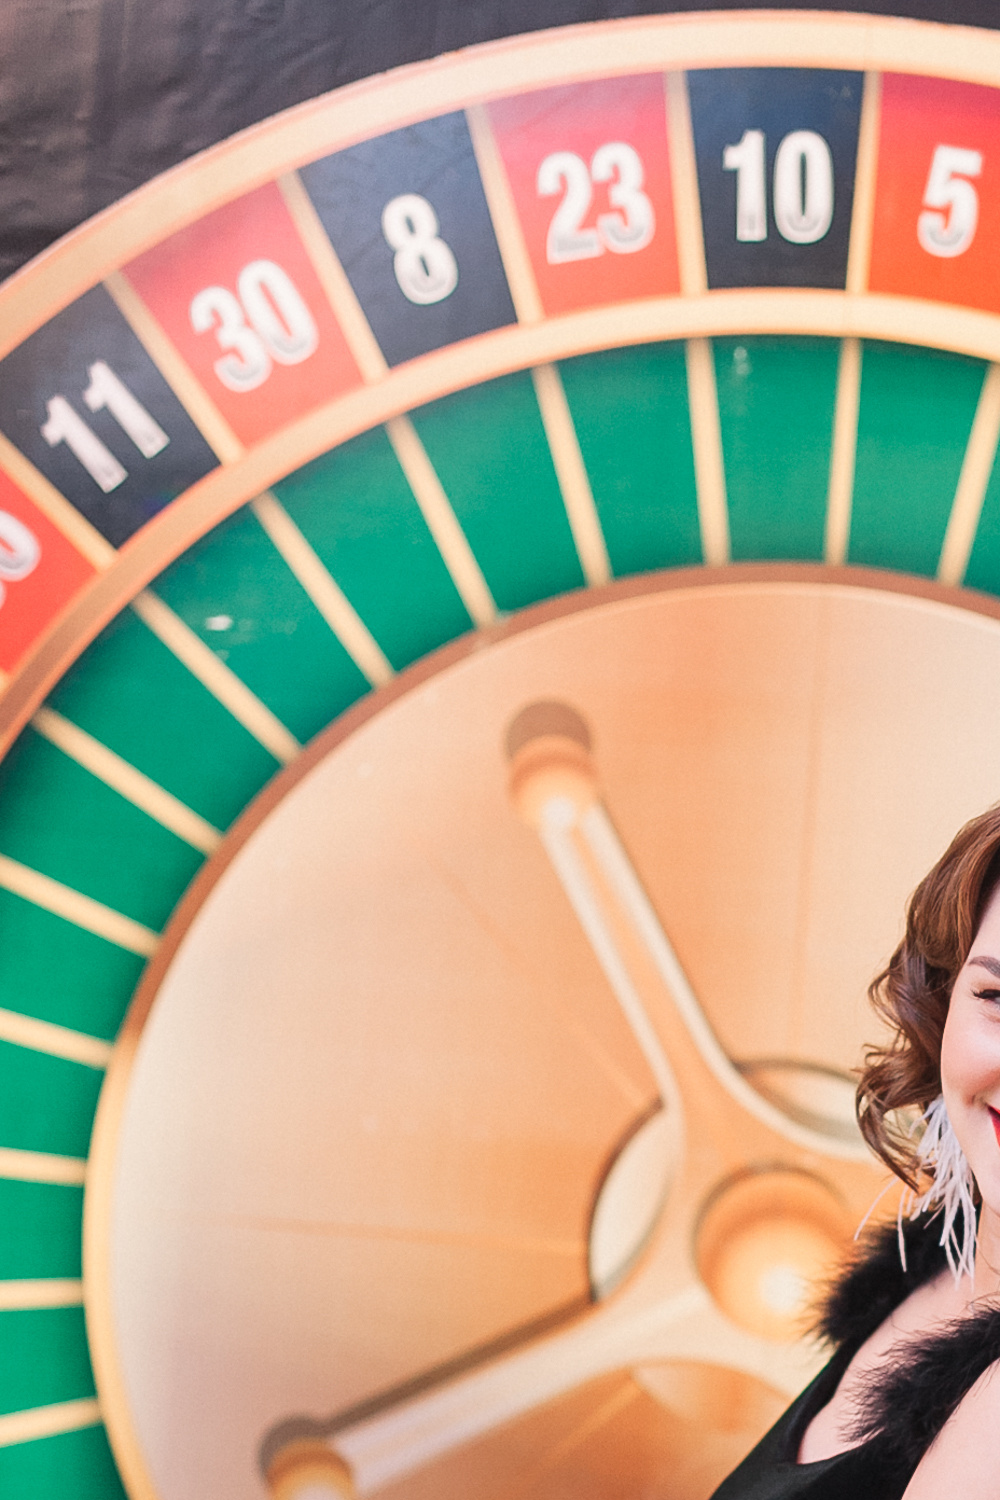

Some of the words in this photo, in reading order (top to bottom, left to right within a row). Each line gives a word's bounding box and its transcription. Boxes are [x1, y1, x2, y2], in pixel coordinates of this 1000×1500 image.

[537, 141, 655, 265] 23
[724, 129, 835, 244] 10
[917, 144, 983, 258] 5
[381, 193, 458, 304] 8
[190, 259, 318, 393] 30
[42, 360, 170, 493] 11
